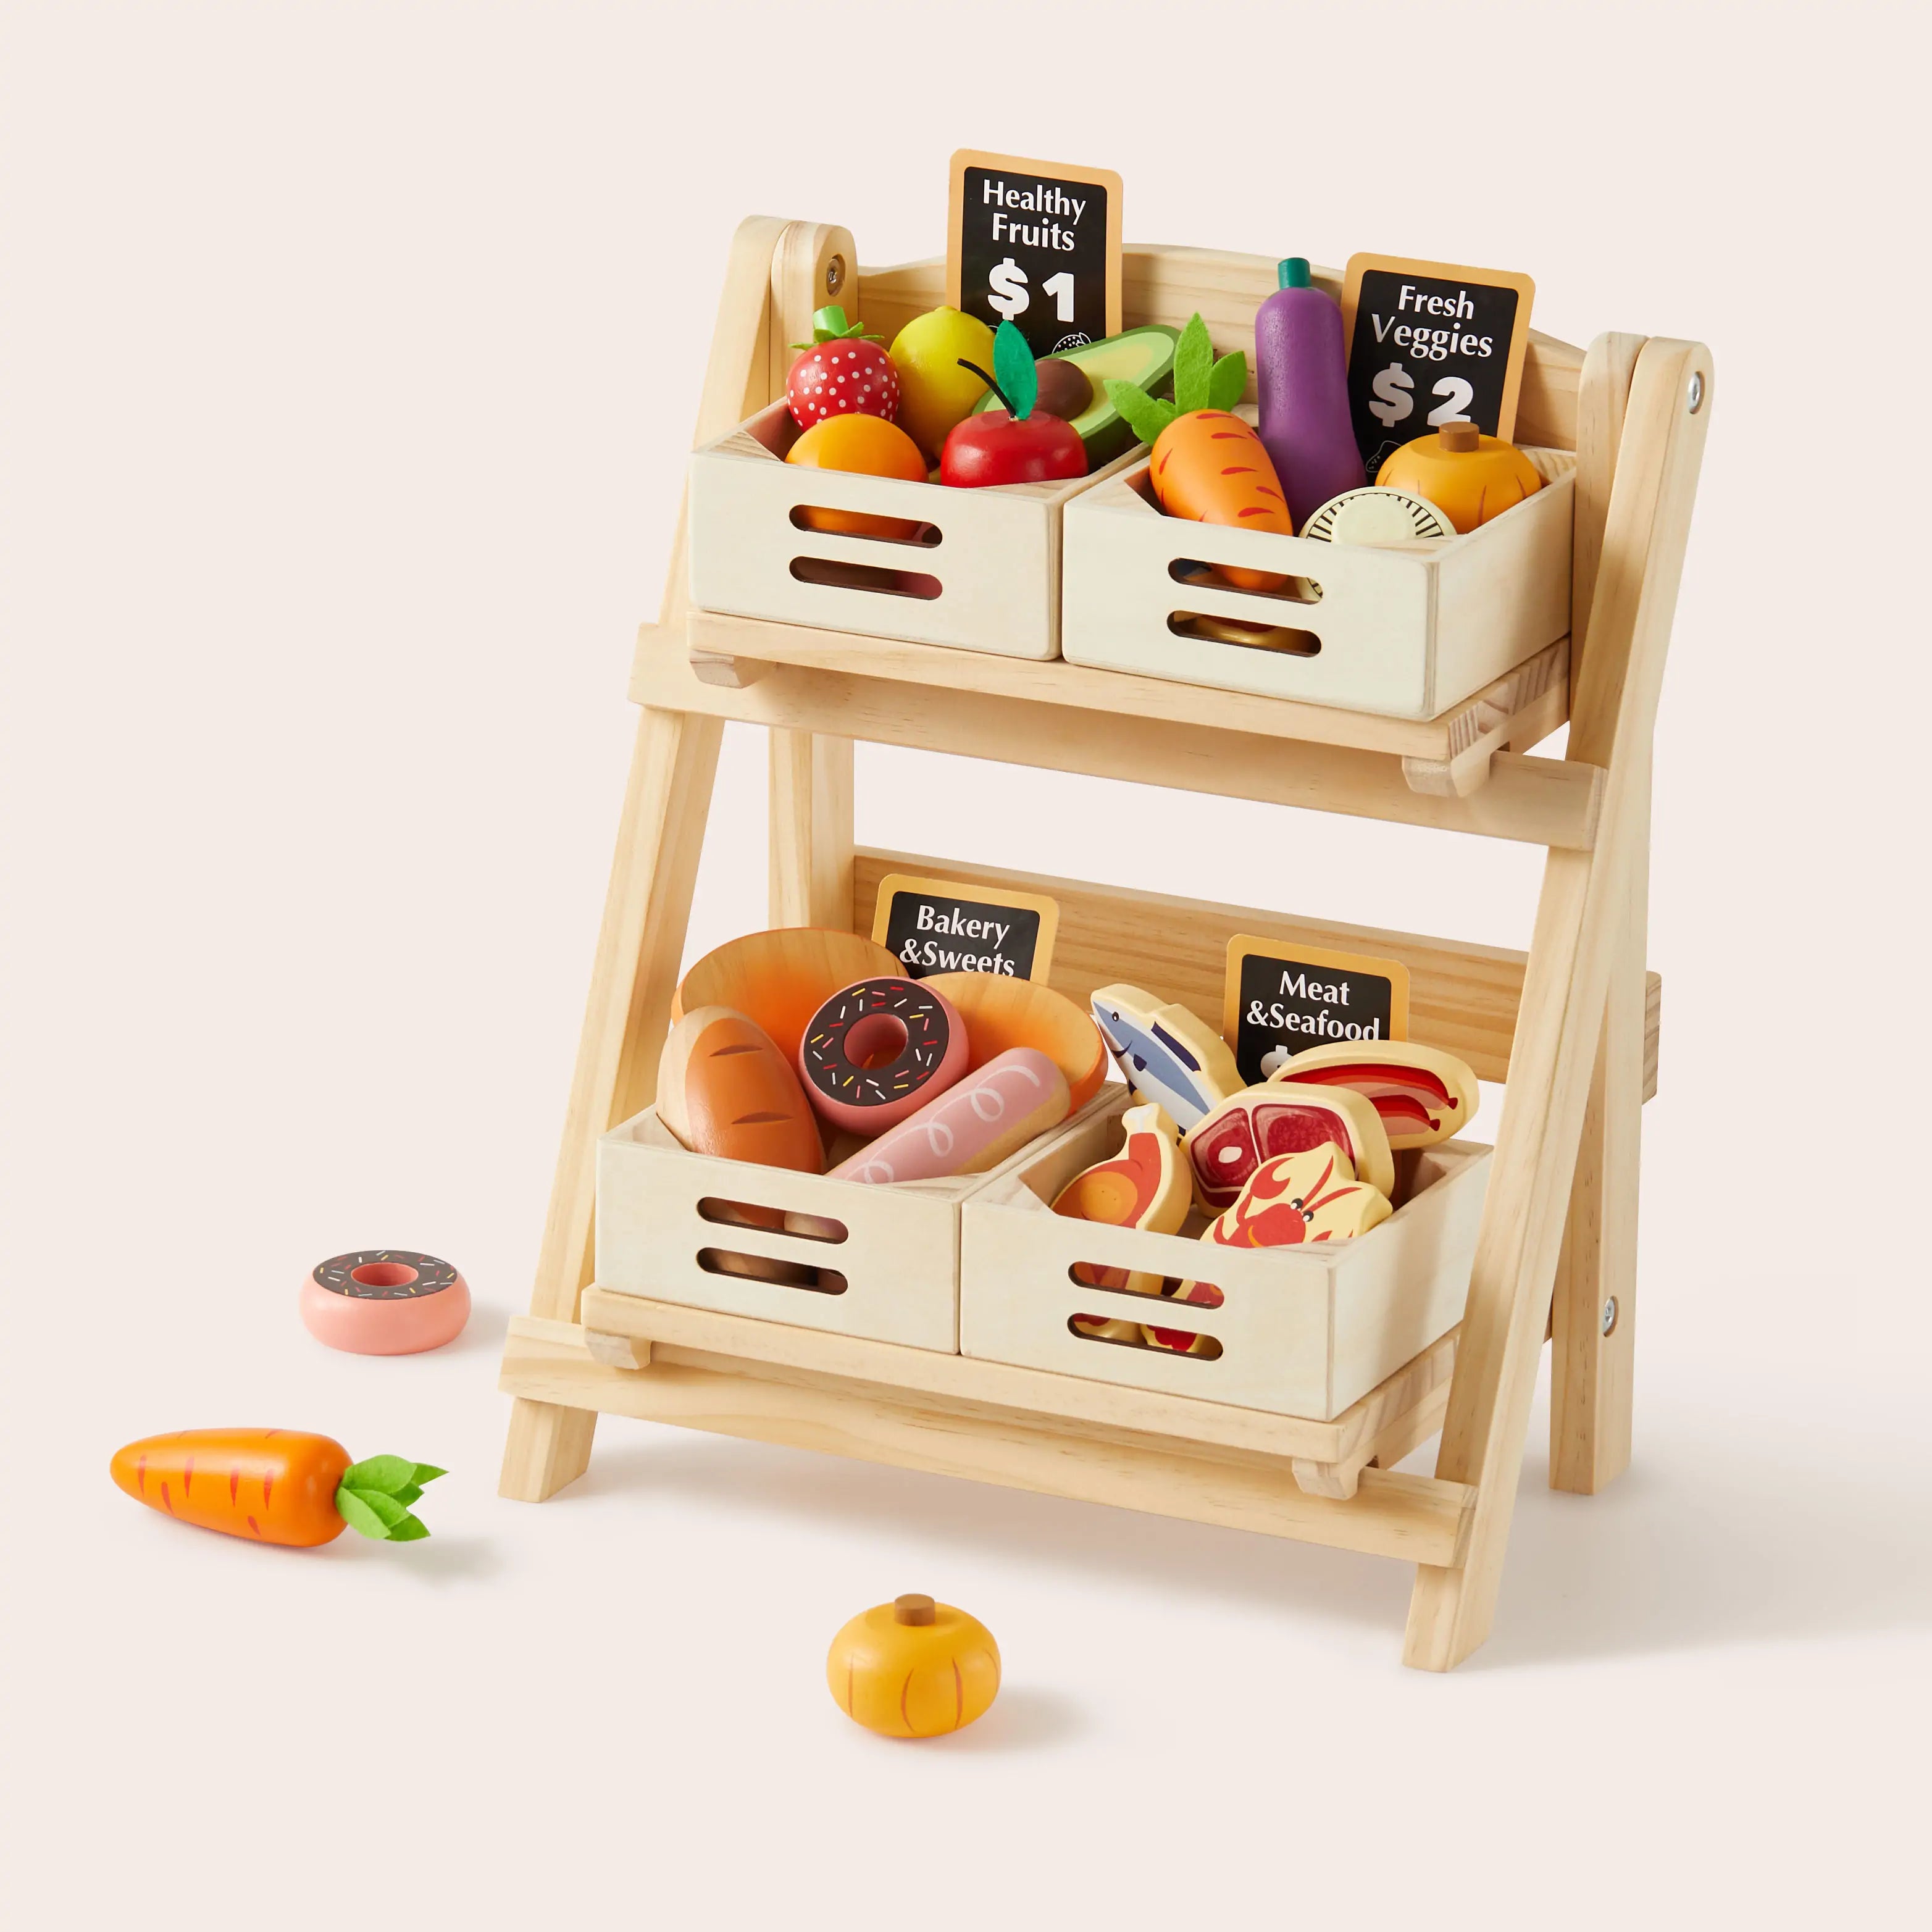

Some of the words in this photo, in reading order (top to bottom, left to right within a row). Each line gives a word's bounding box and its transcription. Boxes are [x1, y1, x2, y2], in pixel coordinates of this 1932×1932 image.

[983, 178, 1087, 225] Healthy
[992, 212, 1075, 251] Fruits
[1398, 285, 1474, 320] Fresh
[1371, 313, 1494, 361] Veggies
[916, 905, 1010, 950] Bakery
[899, 938, 1016, 977] &Sweets
[1279, 971, 1350, 1006] Meat
[1246, 1000, 1381, 1041] &Seafood
